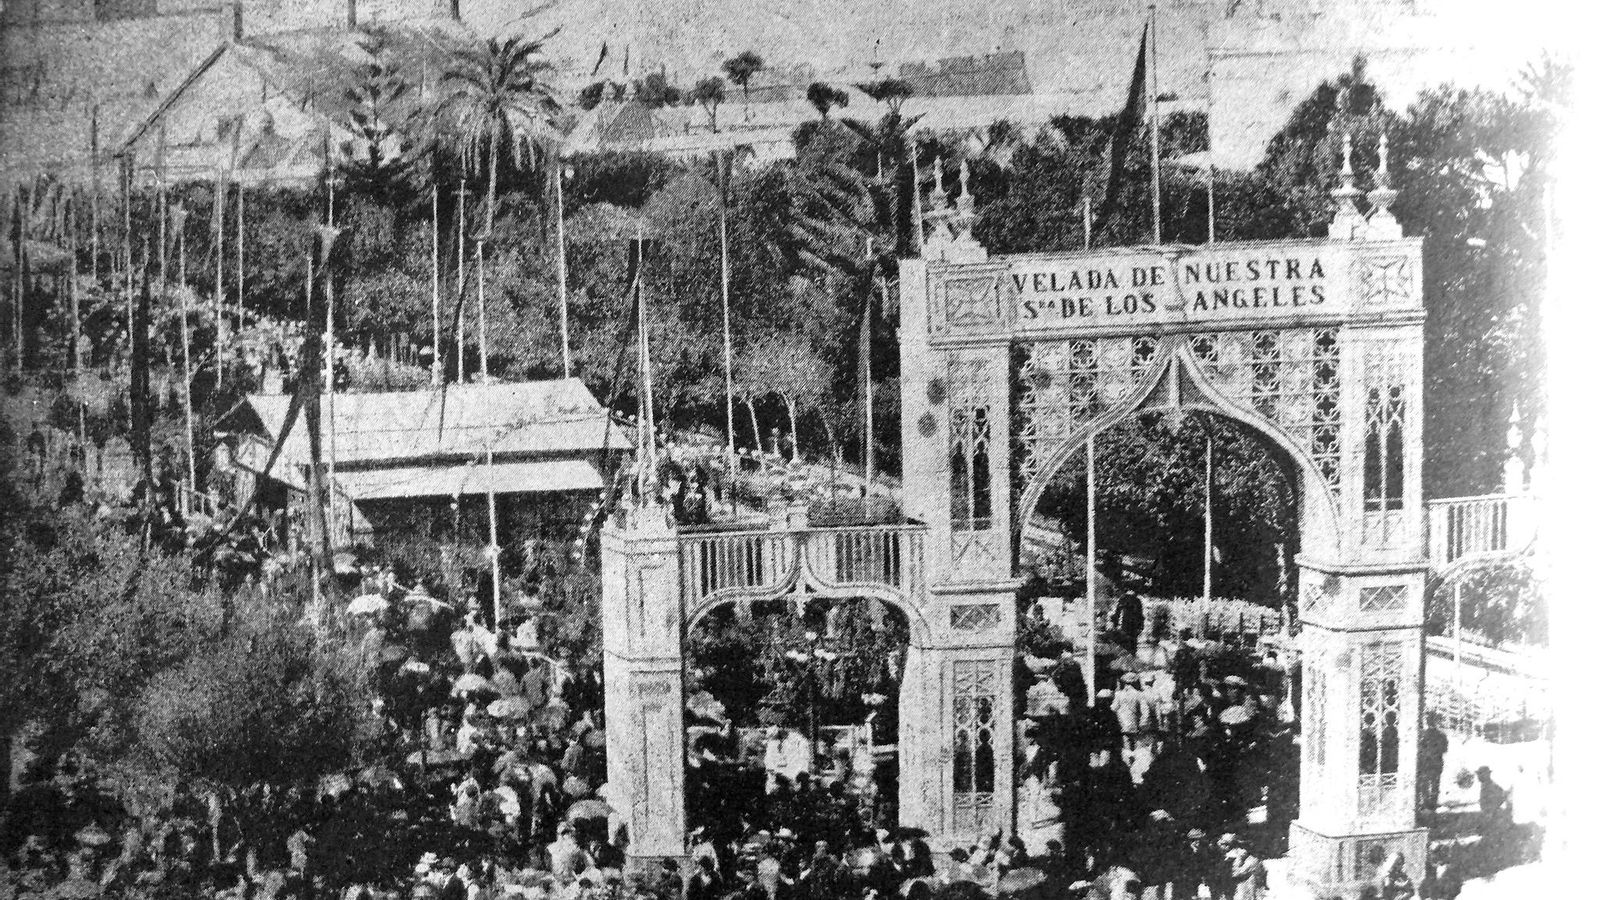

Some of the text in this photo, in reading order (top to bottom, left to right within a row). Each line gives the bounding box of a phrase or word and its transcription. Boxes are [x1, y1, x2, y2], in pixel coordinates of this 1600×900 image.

[1012, 258, 1325, 294] VELADA DE NUESTRA
[1061, 297, 1093, 318] DE
[1106, 293, 1157, 316] LOS
[1193, 285, 1325, 312] ANGELES
